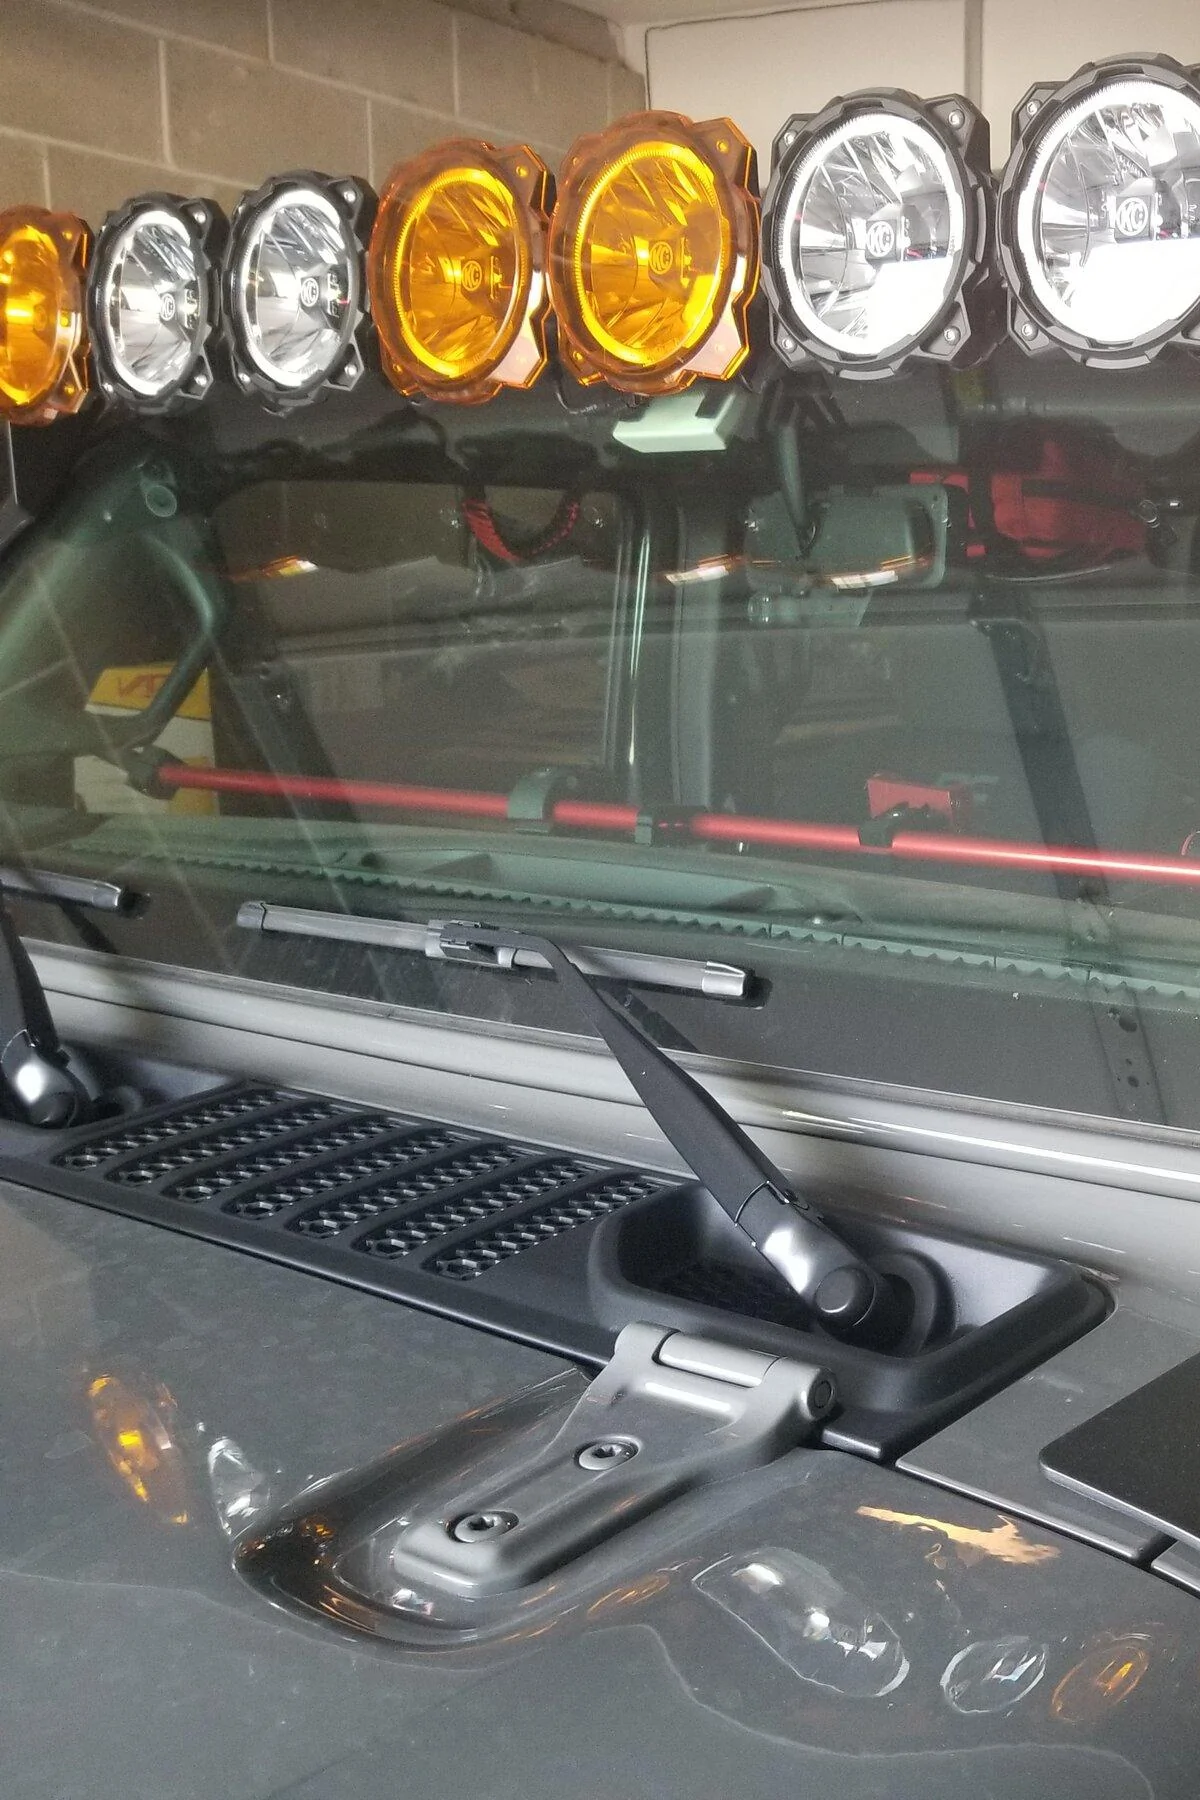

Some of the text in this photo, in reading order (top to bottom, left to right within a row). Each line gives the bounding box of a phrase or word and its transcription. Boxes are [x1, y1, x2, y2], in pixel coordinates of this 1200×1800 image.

[1118, 198, 1147, 235] KC
[652, 243, 672, 273] KC
[463, 262, 481, 290] KC
